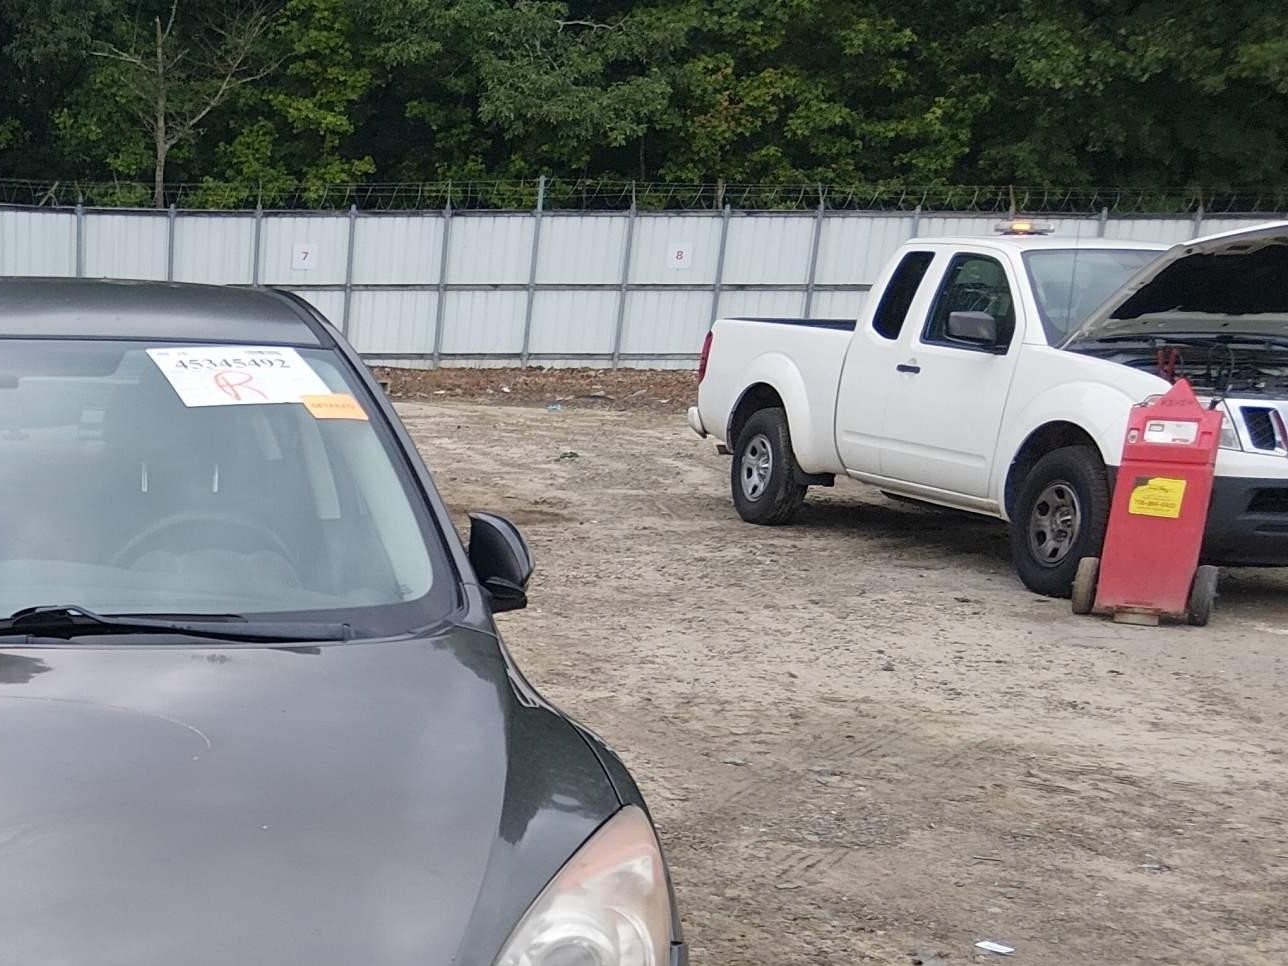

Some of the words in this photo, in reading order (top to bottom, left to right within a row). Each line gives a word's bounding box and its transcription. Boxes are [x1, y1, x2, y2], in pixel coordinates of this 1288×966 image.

[301, 251, 309, 261] 7
[675, 250, 684, 260] 8
[175, 358, 291, 370] 45345492
[214, 370, 270, 401] R
